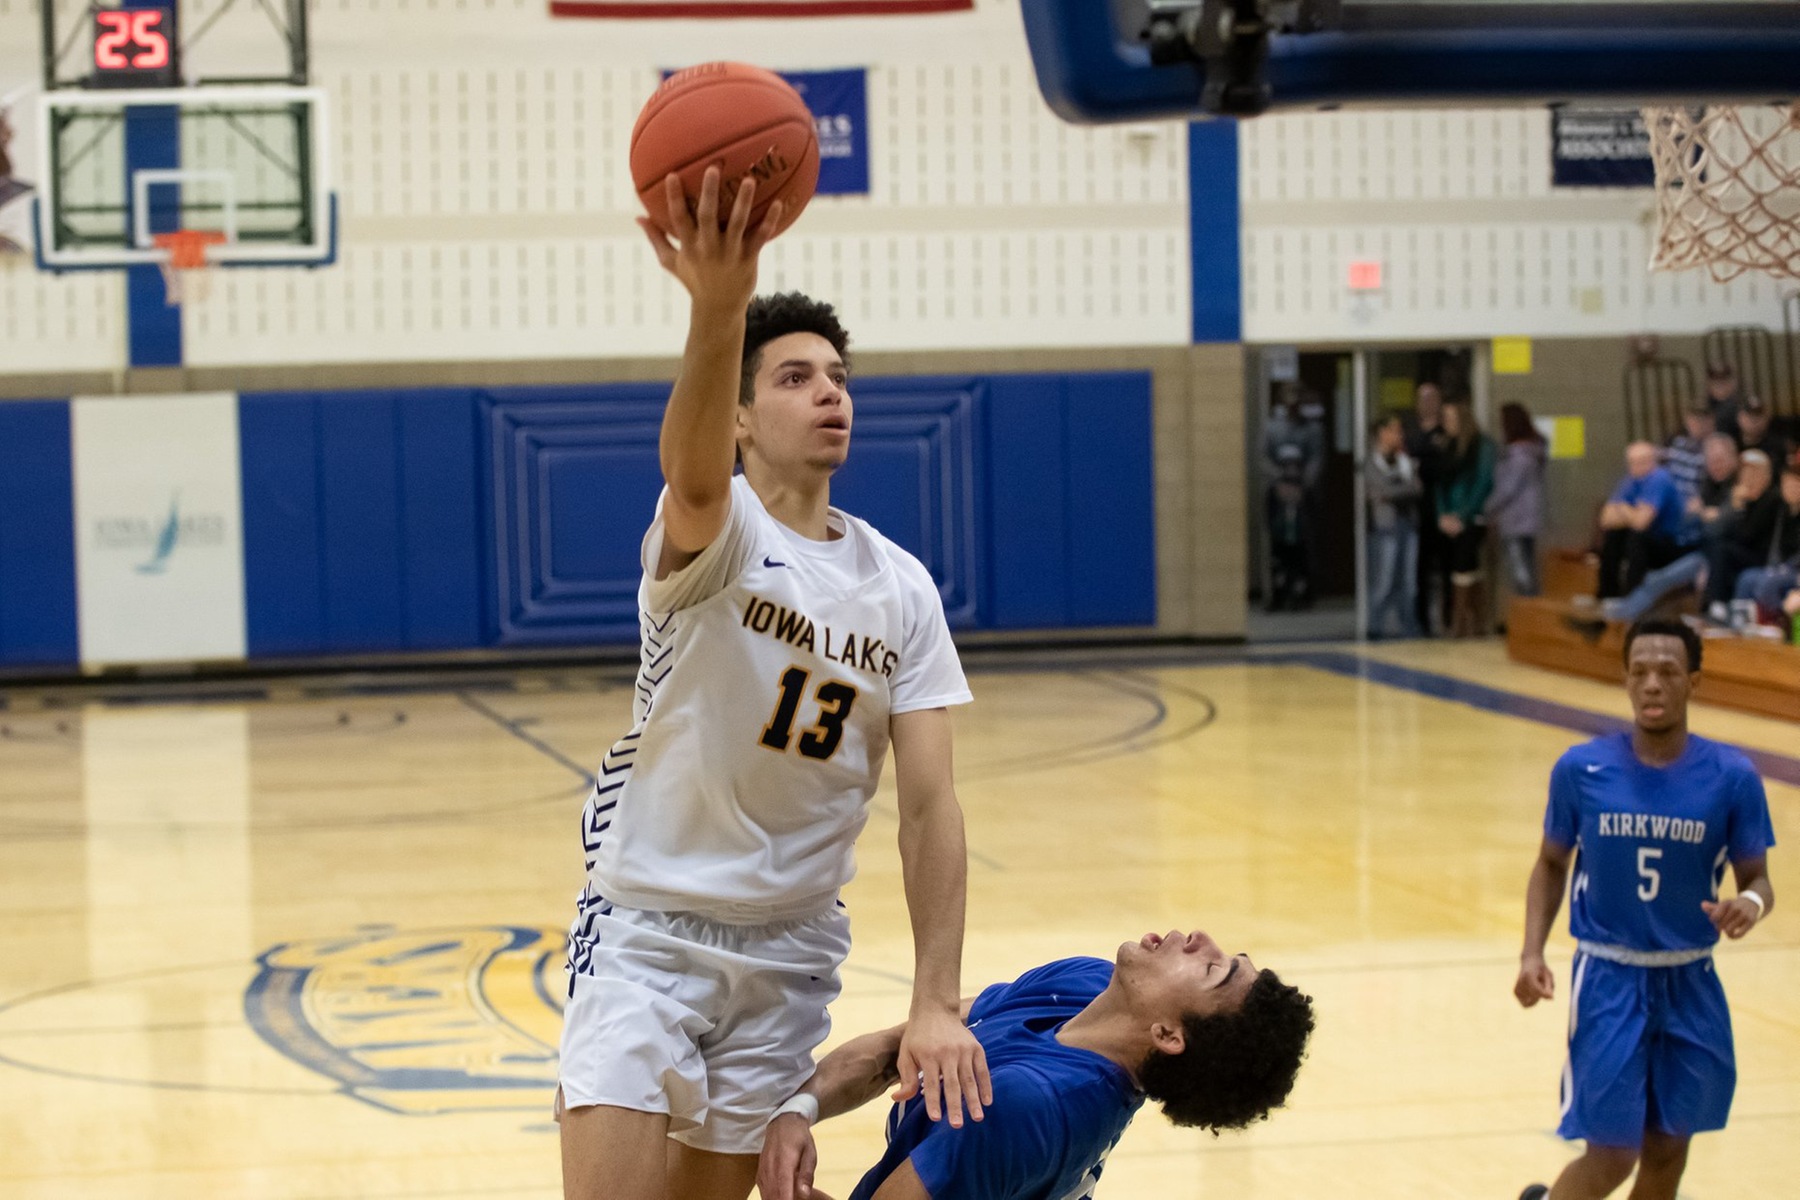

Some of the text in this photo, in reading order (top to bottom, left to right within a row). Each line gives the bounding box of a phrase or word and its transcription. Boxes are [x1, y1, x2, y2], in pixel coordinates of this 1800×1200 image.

[95, 10, 169, 69] 25
[741, 596, 899, 678] IOWA LAKS
[757, 663, 860, 763] 13
[1598, 812, 1706, 845] KIRKWOOD
[1636, 846, 1664, 902] 5
